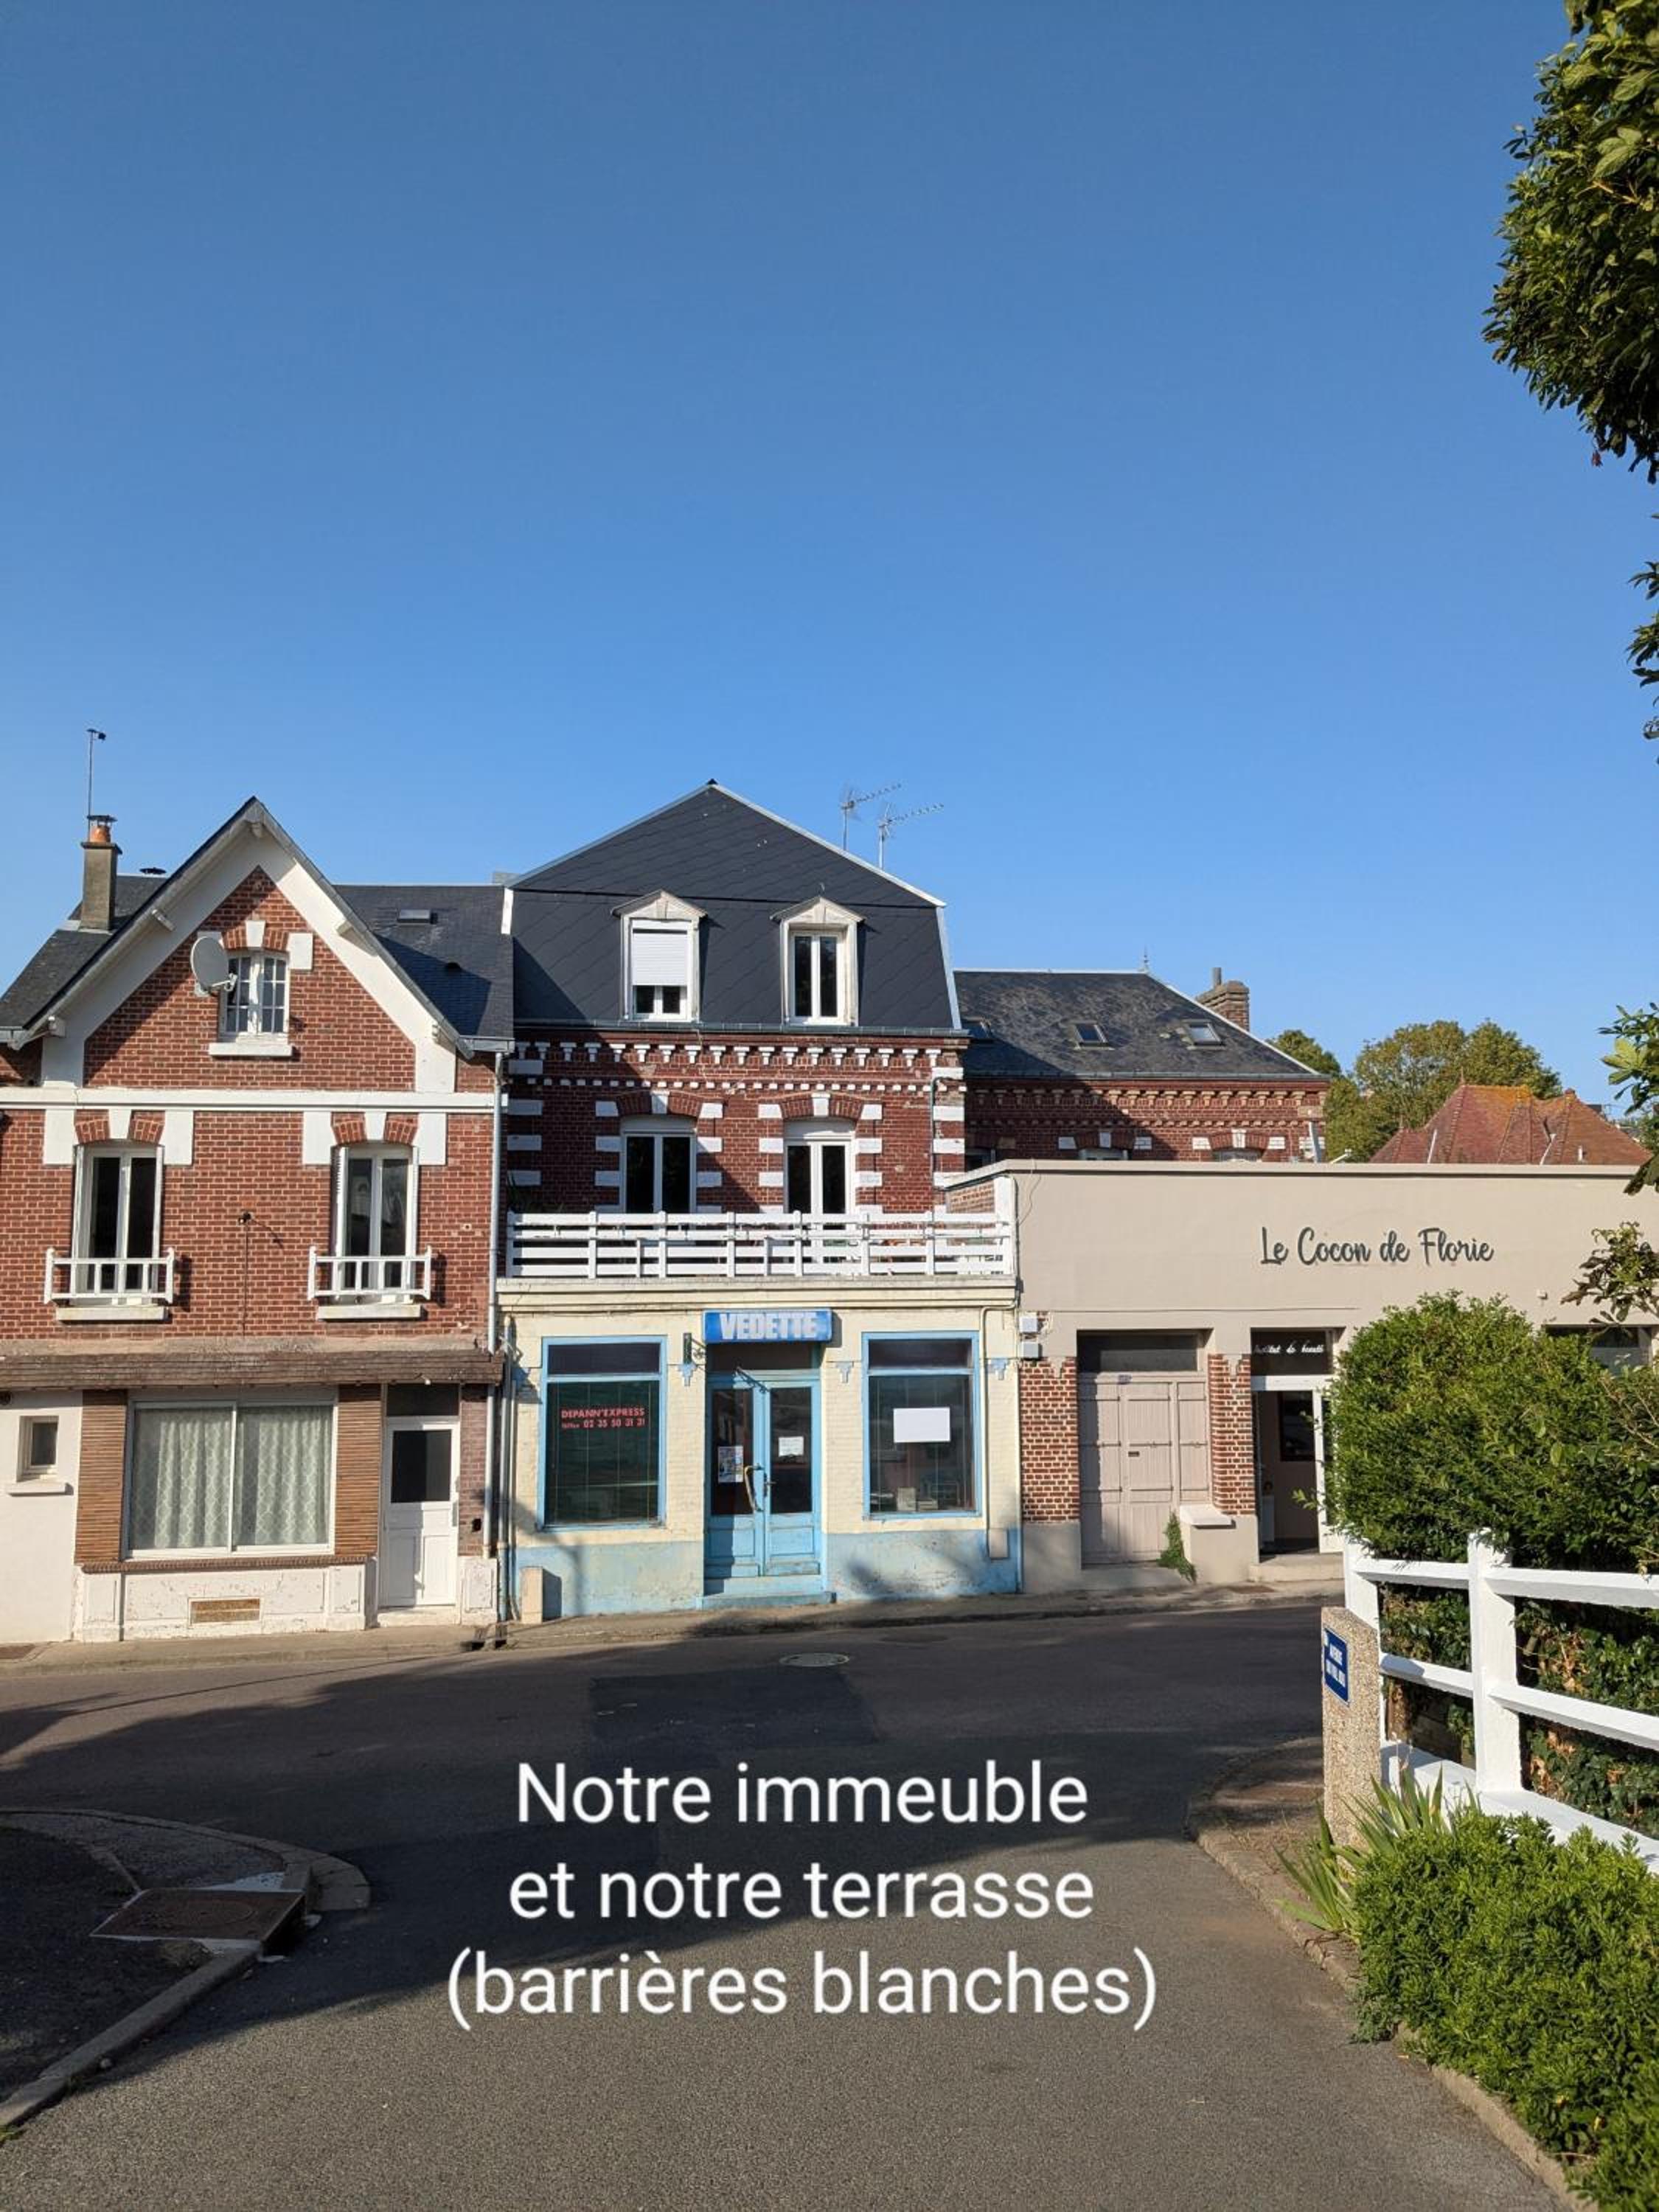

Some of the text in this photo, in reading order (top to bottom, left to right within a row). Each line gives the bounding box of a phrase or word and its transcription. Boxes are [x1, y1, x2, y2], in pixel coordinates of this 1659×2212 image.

[1261, 1226, 1495, 1266] Le Cocon de Florie
[719, 1312, 818, 1340] VEDETTE
